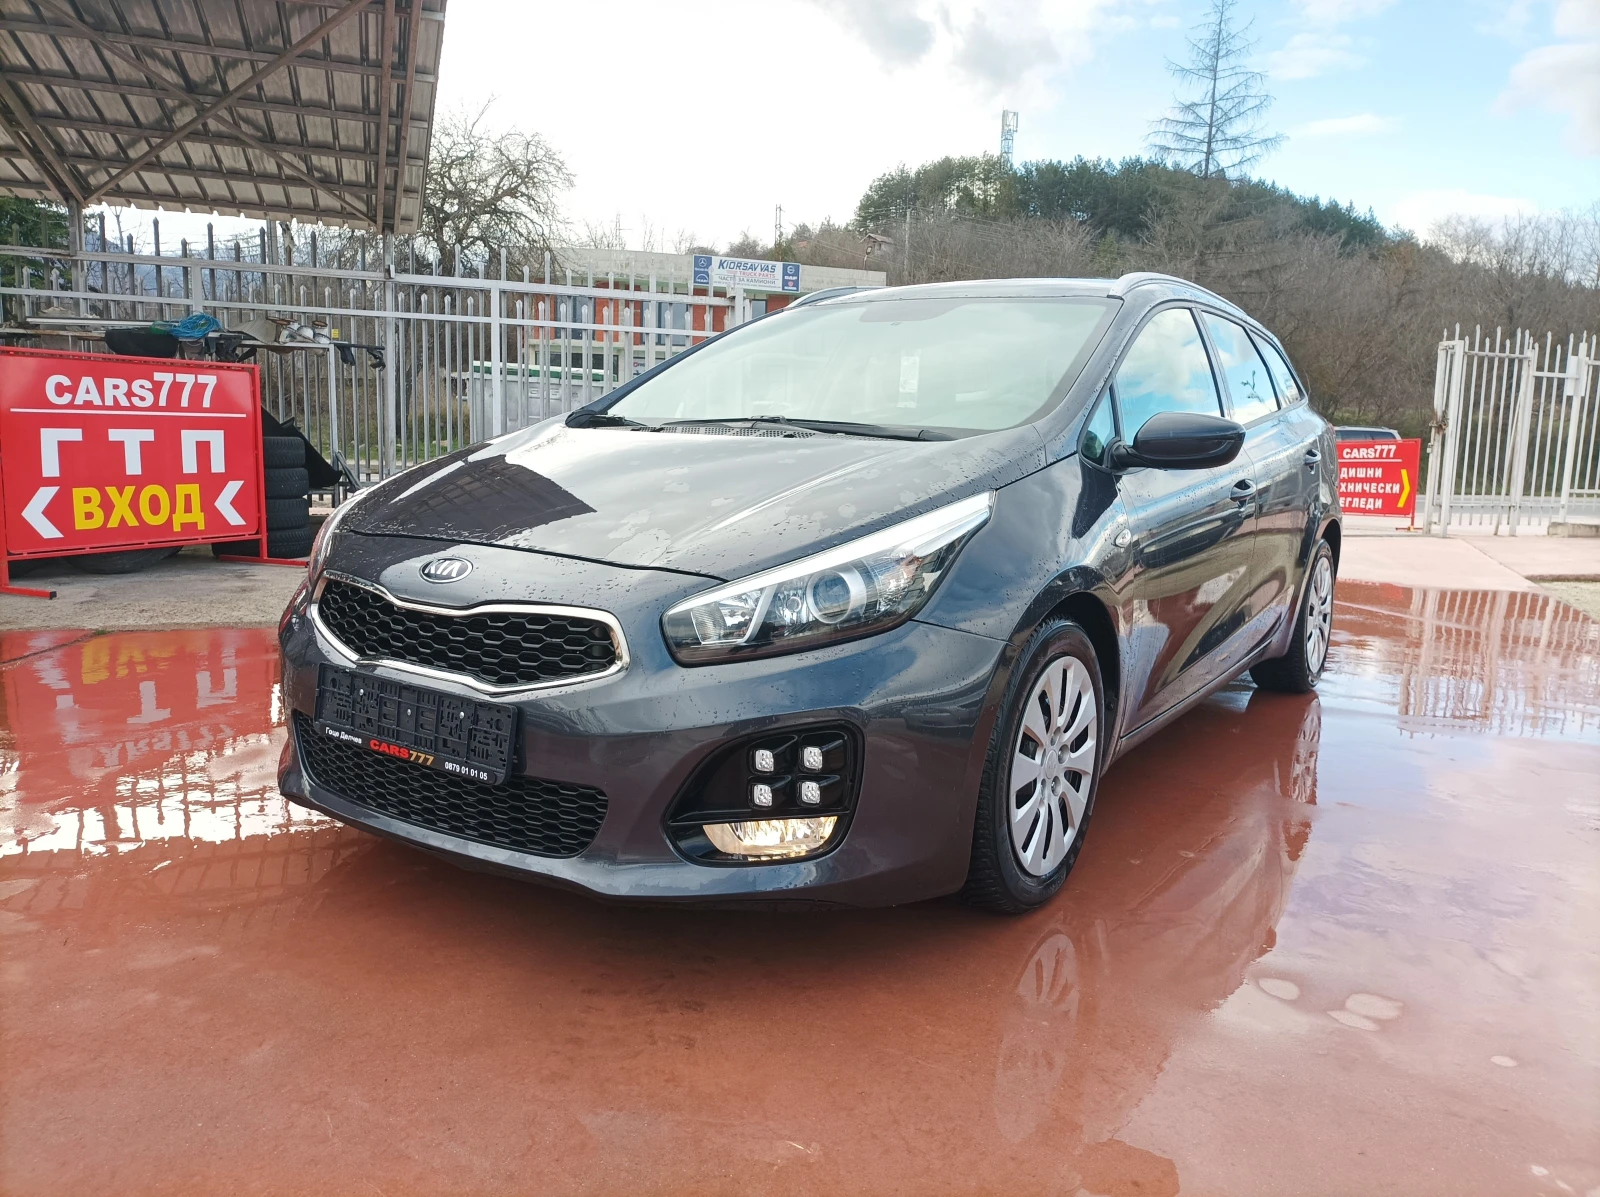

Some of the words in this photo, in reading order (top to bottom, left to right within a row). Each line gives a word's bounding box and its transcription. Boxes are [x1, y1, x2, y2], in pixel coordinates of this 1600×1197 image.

[45, 372, 217, 408] CARS777
[1343, 445, 1396, 458] CARS777
[1340, 467, 1383, 480] ДИШНИ
[1339, 482, 1400, 494] ХНИЧЕСКИ
[72, 484, 205, 532] ВХОД
[1339, 497, 1383, 510] ЕГЛЕДИ
[423, 559, 462, 578] KIA
[369, 739, 435, 766] CARS777
[444, 761, 460, 773] 0879
[461, 765, 469, 775] 01
[470, 768, 478, 778] 01
[479, 771, 488, 781] 05
